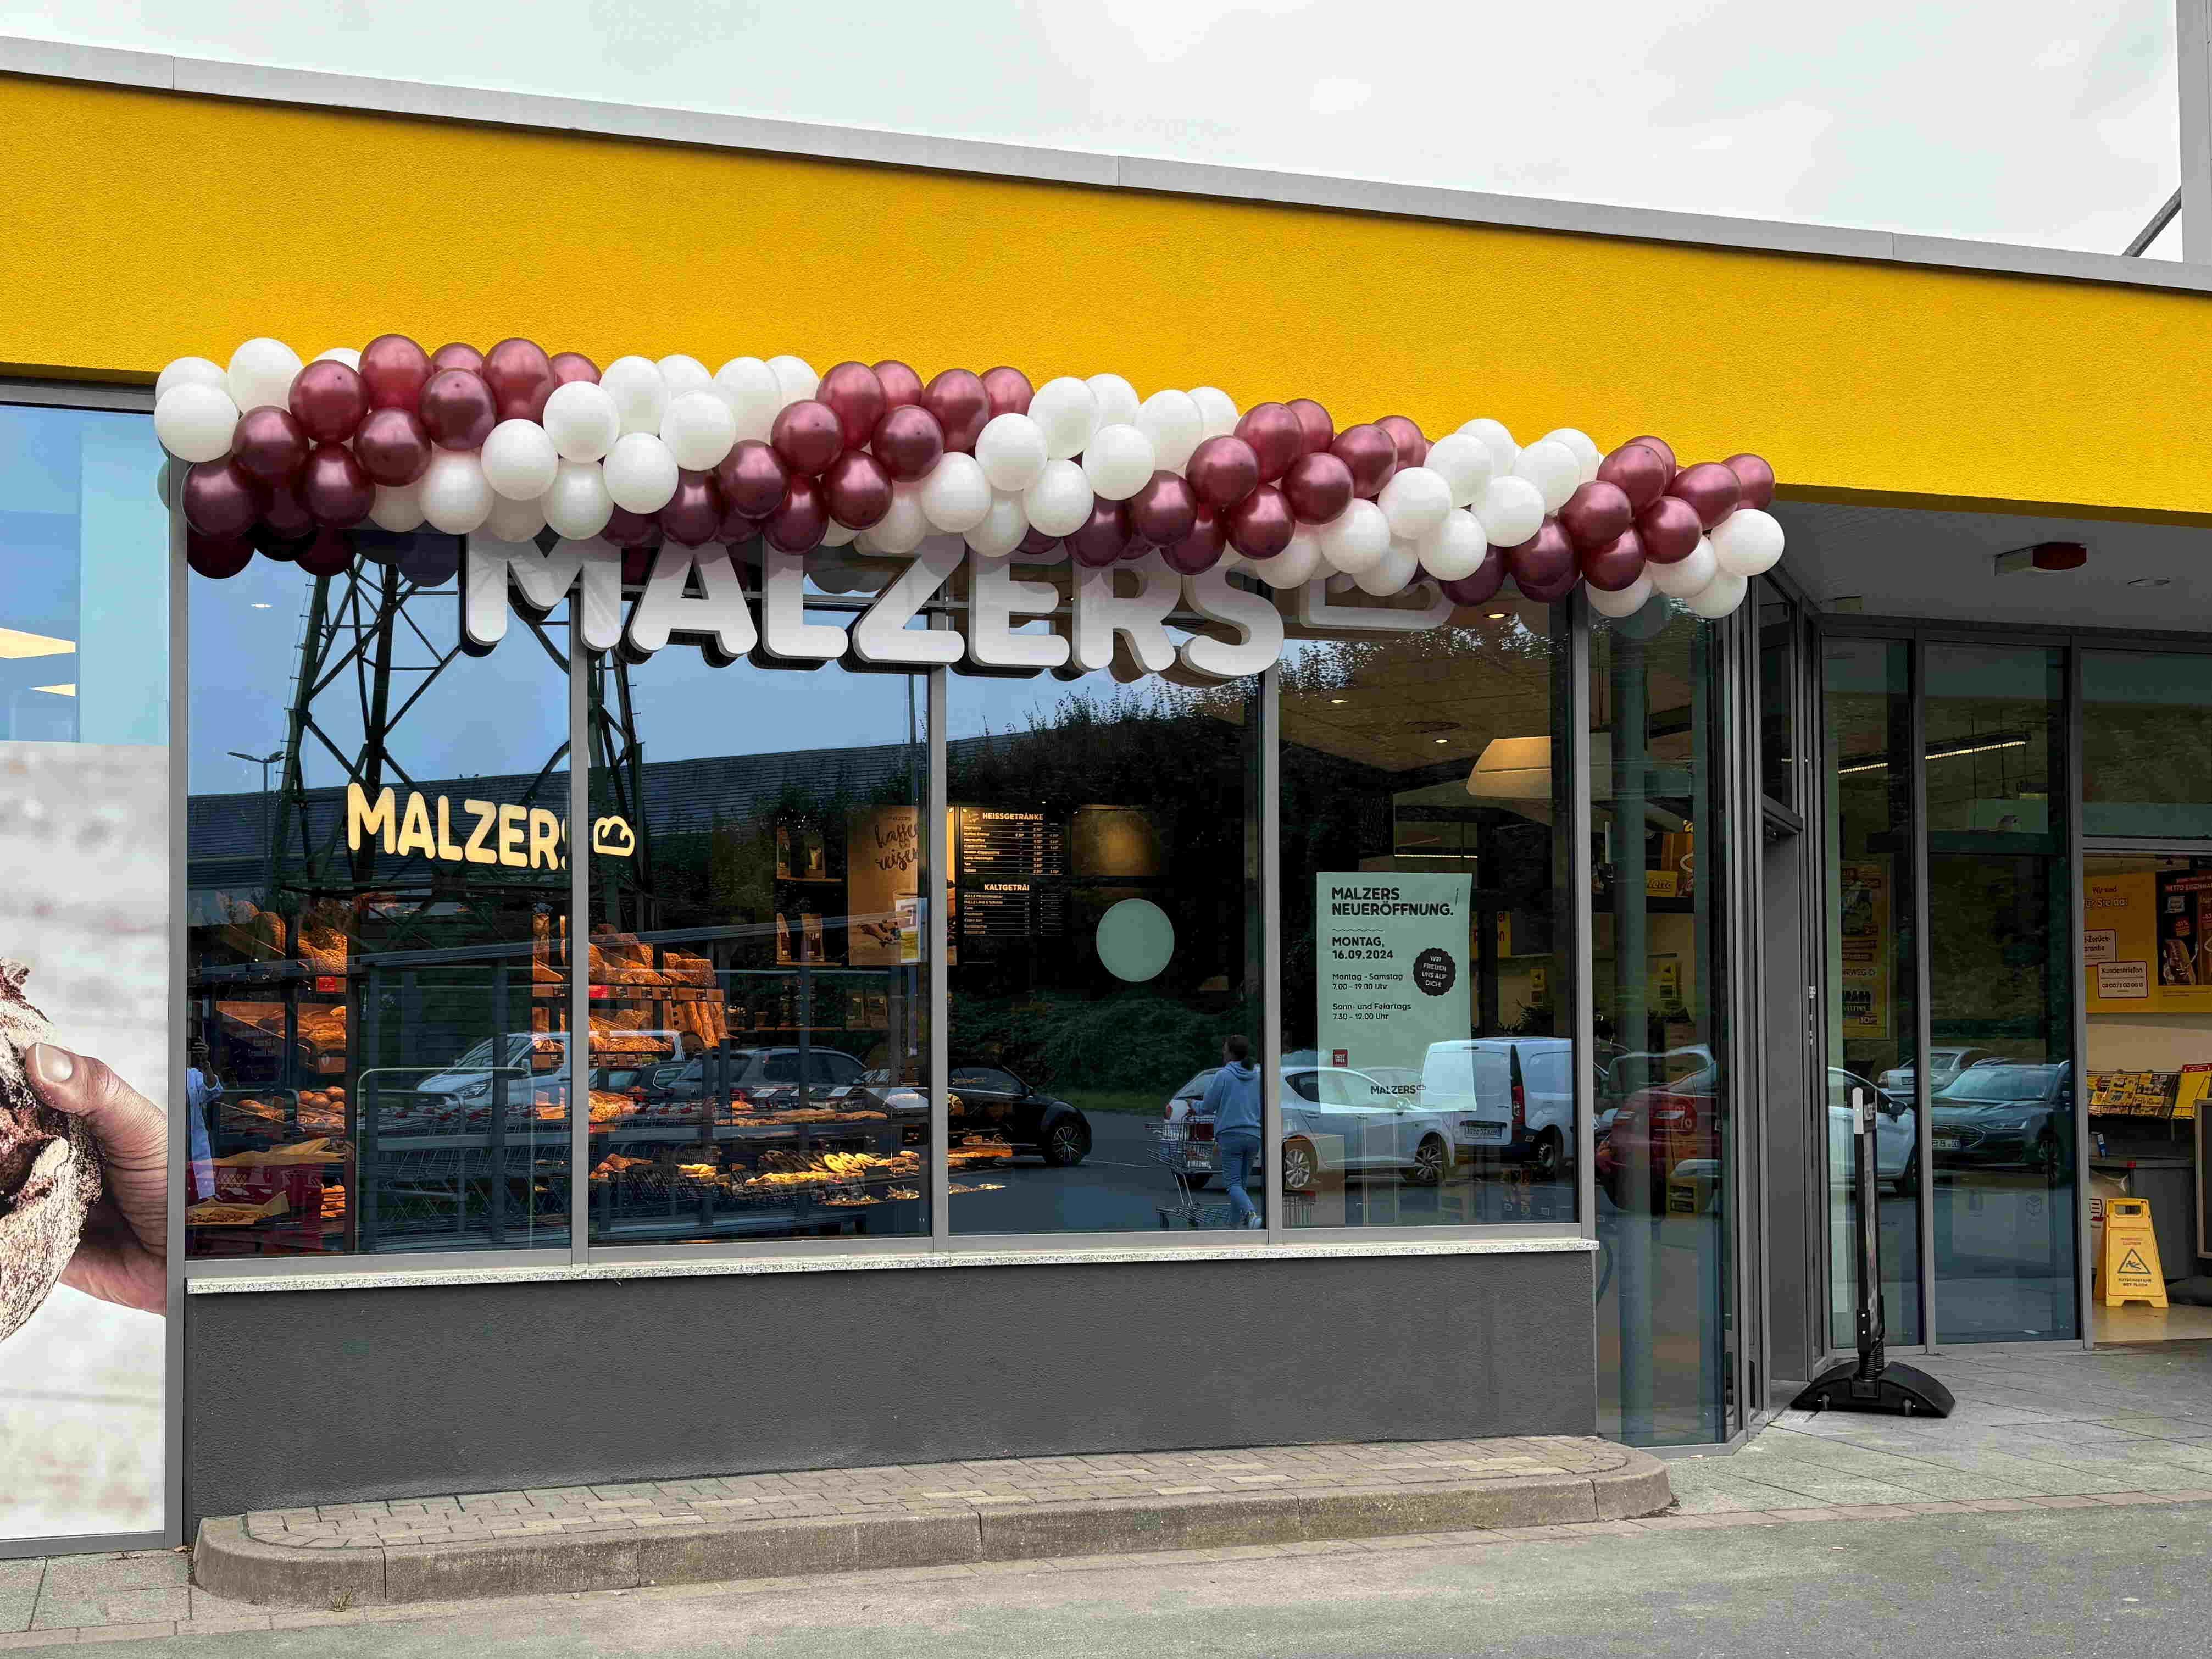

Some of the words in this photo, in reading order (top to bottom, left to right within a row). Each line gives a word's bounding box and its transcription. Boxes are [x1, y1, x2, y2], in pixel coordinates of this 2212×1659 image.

[467, 532, 1284, 677] MALZERS
[982, 812, 1043, 820] HEISSGETRÄNKE
[348, 782, 565, 870] MALZER
[984, 883, 1029, 891] KALTGETRÄ
[1332, 887, 1400, 900] MALZERS
[1332, 901, 1454, 916] NEUERÖFFNUNG.
[1332, 936, 1385, 948] MONTAG,
[1332, 950, 1394, 959] 16.09.2024
[1332, 973, 1362, 981] Montag
[1369, 973, 1403, 981] Samstag
[1374, 1002, 1411, 1011] Feiertags
[1371, 1085, 1416, 1095] MALZERS
